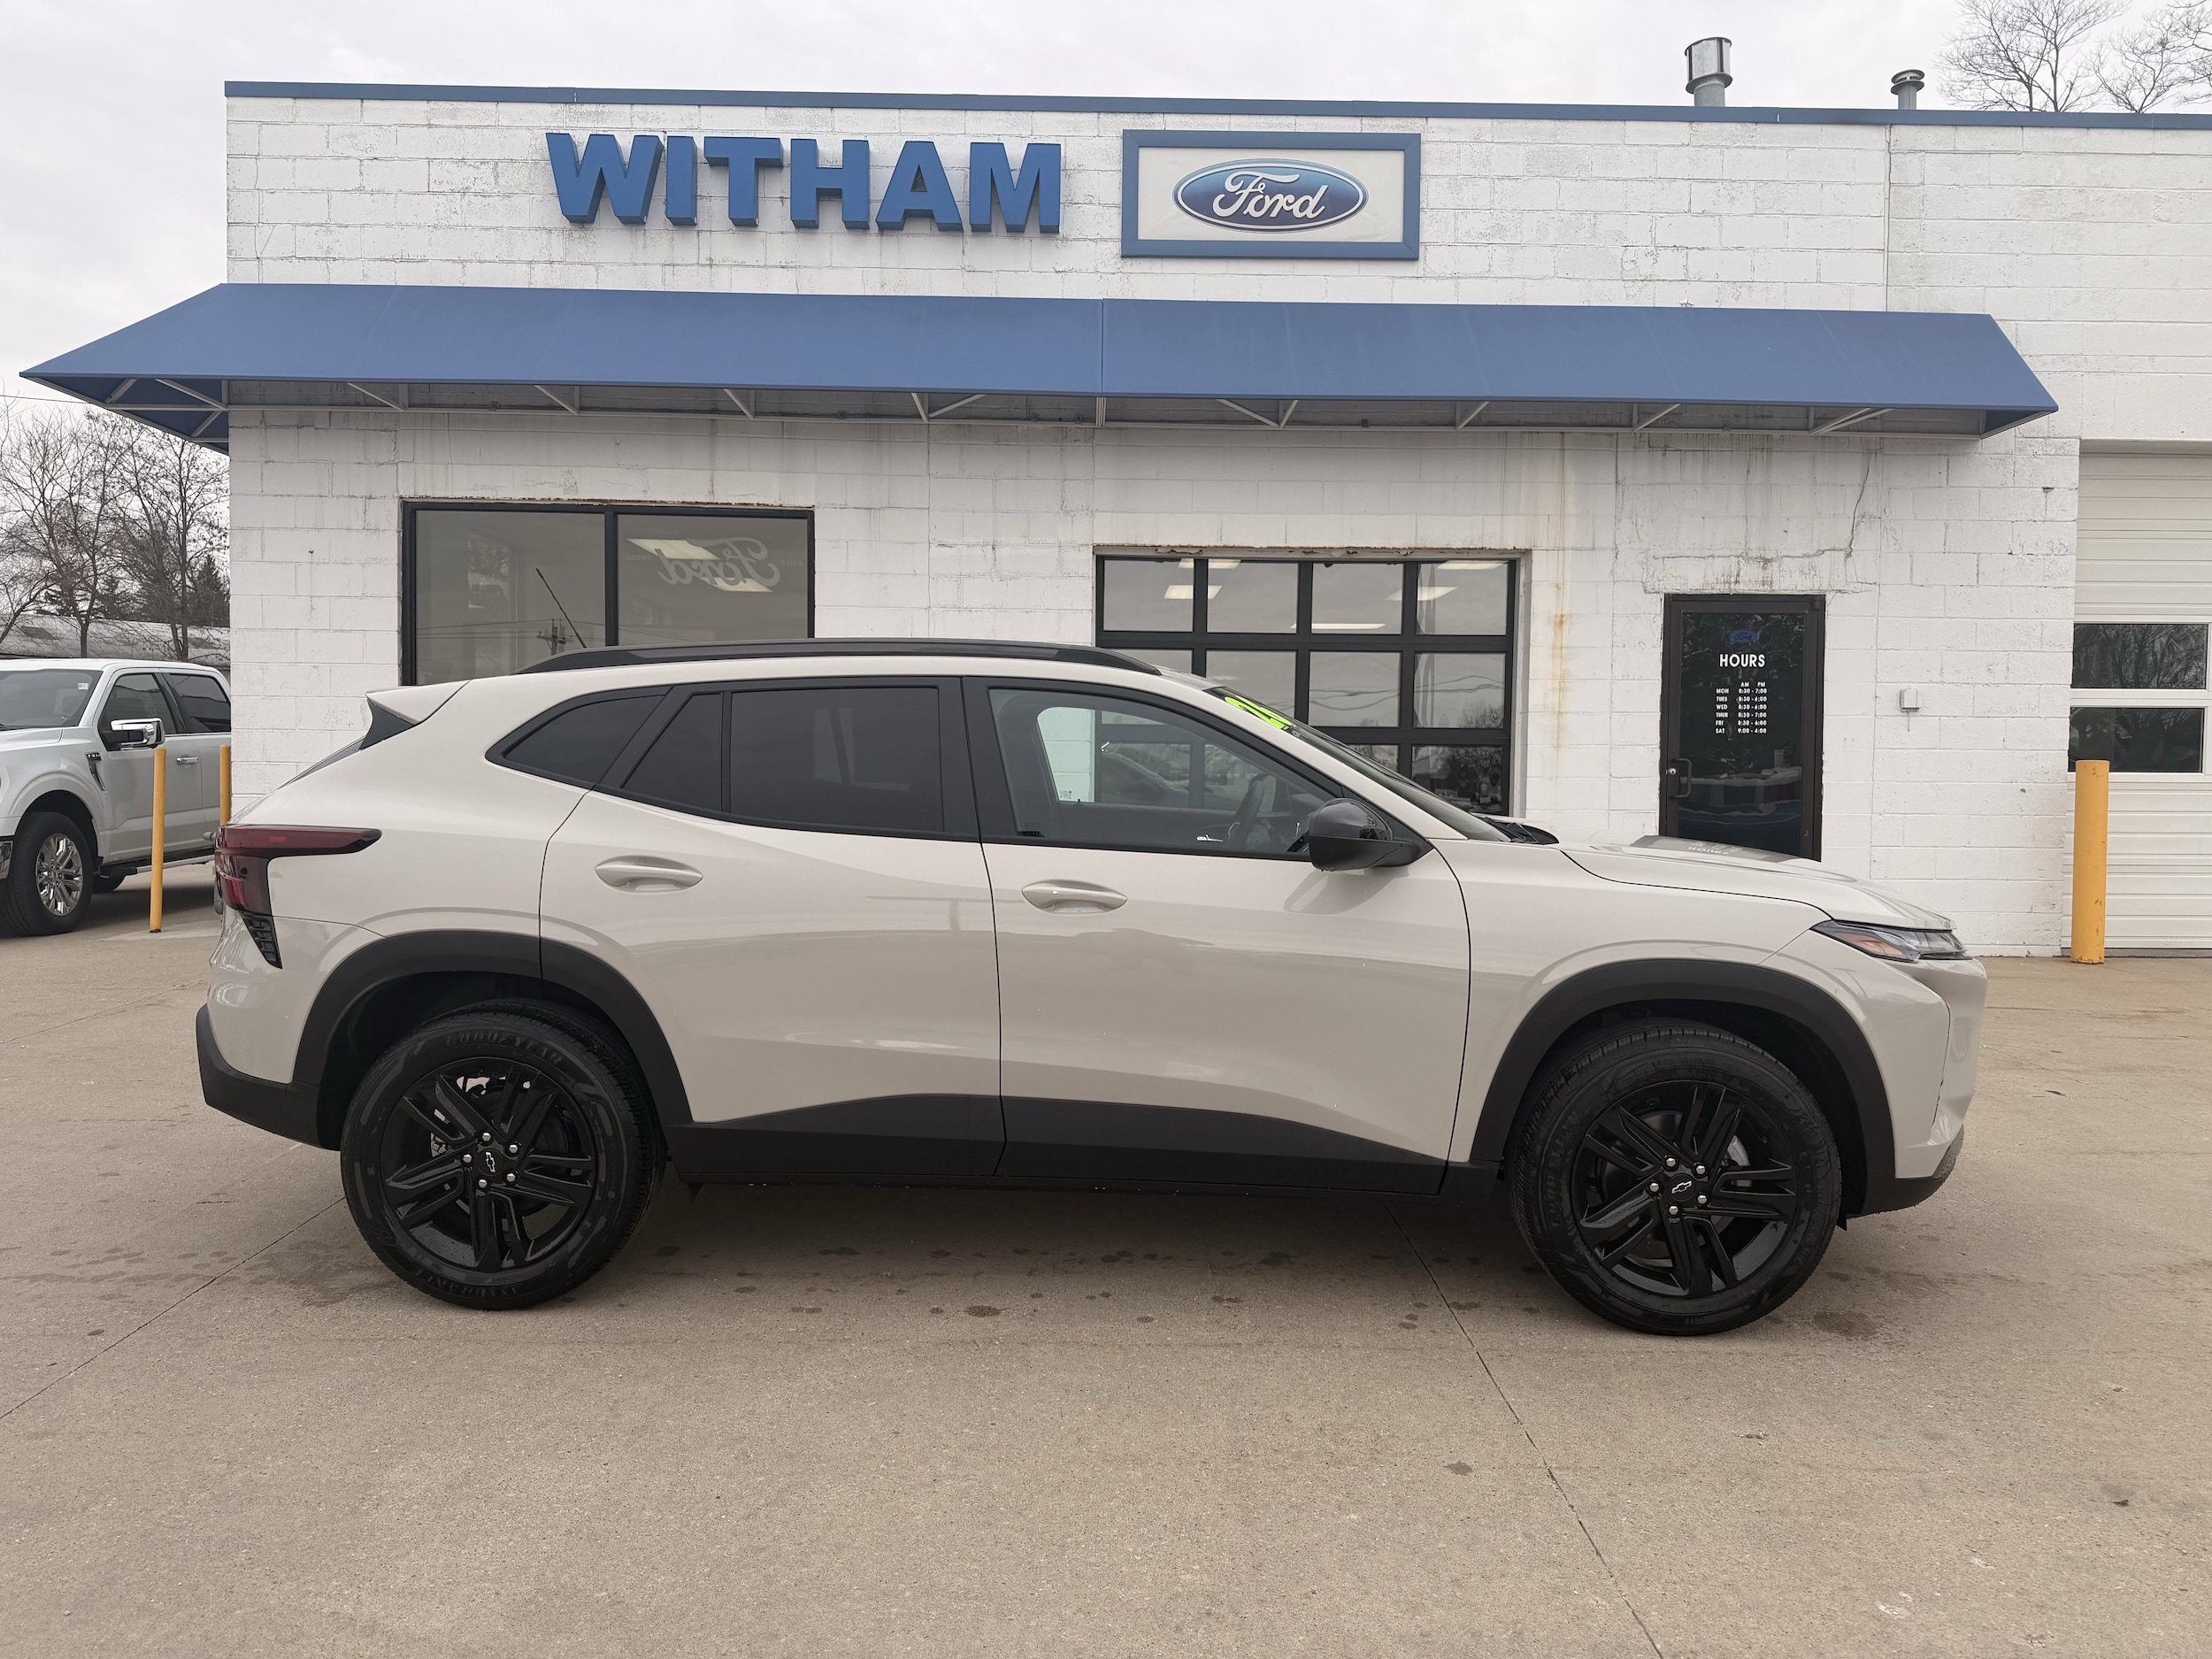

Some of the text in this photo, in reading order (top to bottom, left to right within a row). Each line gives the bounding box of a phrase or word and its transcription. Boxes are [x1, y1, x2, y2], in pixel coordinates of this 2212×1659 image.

[545, 133, 1061, 233] WITHAM
[1212, 171, 1328, 219] Ford
[1719, 653, 1765, 667] HOURS
